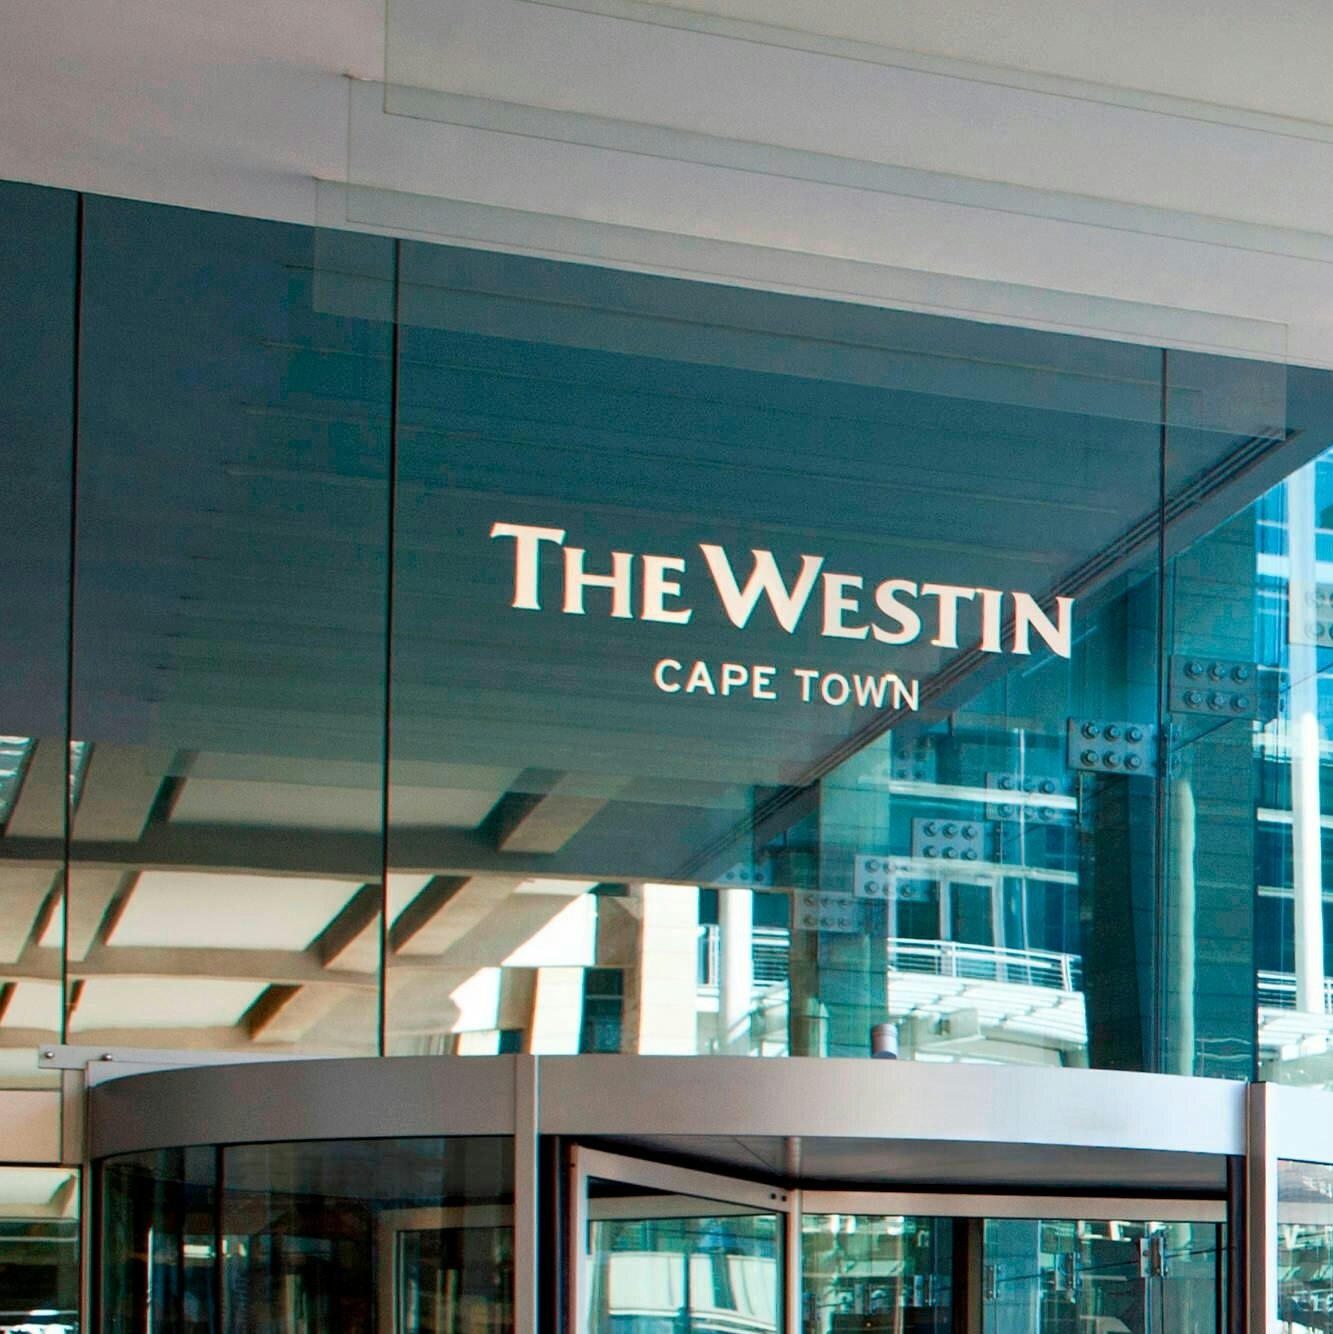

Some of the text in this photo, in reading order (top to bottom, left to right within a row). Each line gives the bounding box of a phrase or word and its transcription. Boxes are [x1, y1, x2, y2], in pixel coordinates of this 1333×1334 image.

[490, 522, 1075, 659] THE WESTIN
[655, 659, 919, 711] CAPE TOWN
